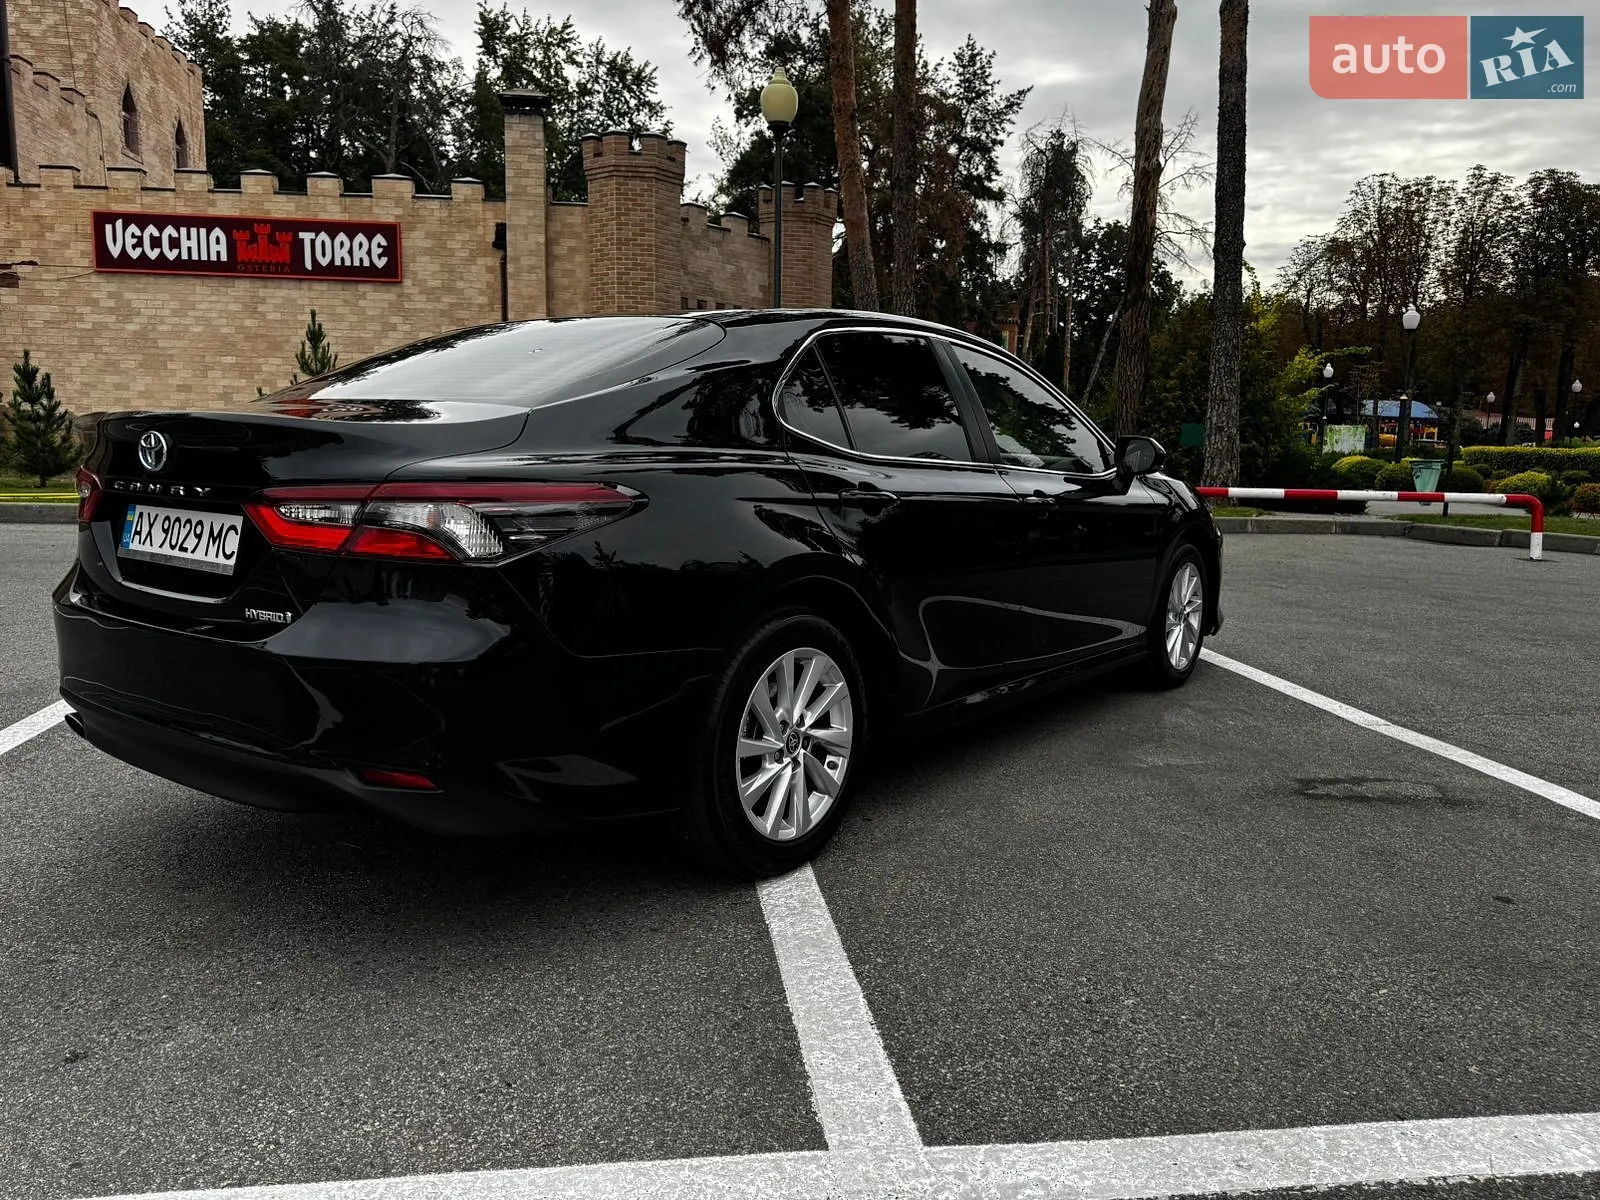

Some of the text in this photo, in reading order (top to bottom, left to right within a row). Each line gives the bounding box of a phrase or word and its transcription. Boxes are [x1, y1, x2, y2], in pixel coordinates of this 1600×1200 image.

[105, 218, 388, 271] VECCHIA TORRE
[131, 511, 239, 560] AX 9029 MC
[245, 608, 284, 622] HYBRID
